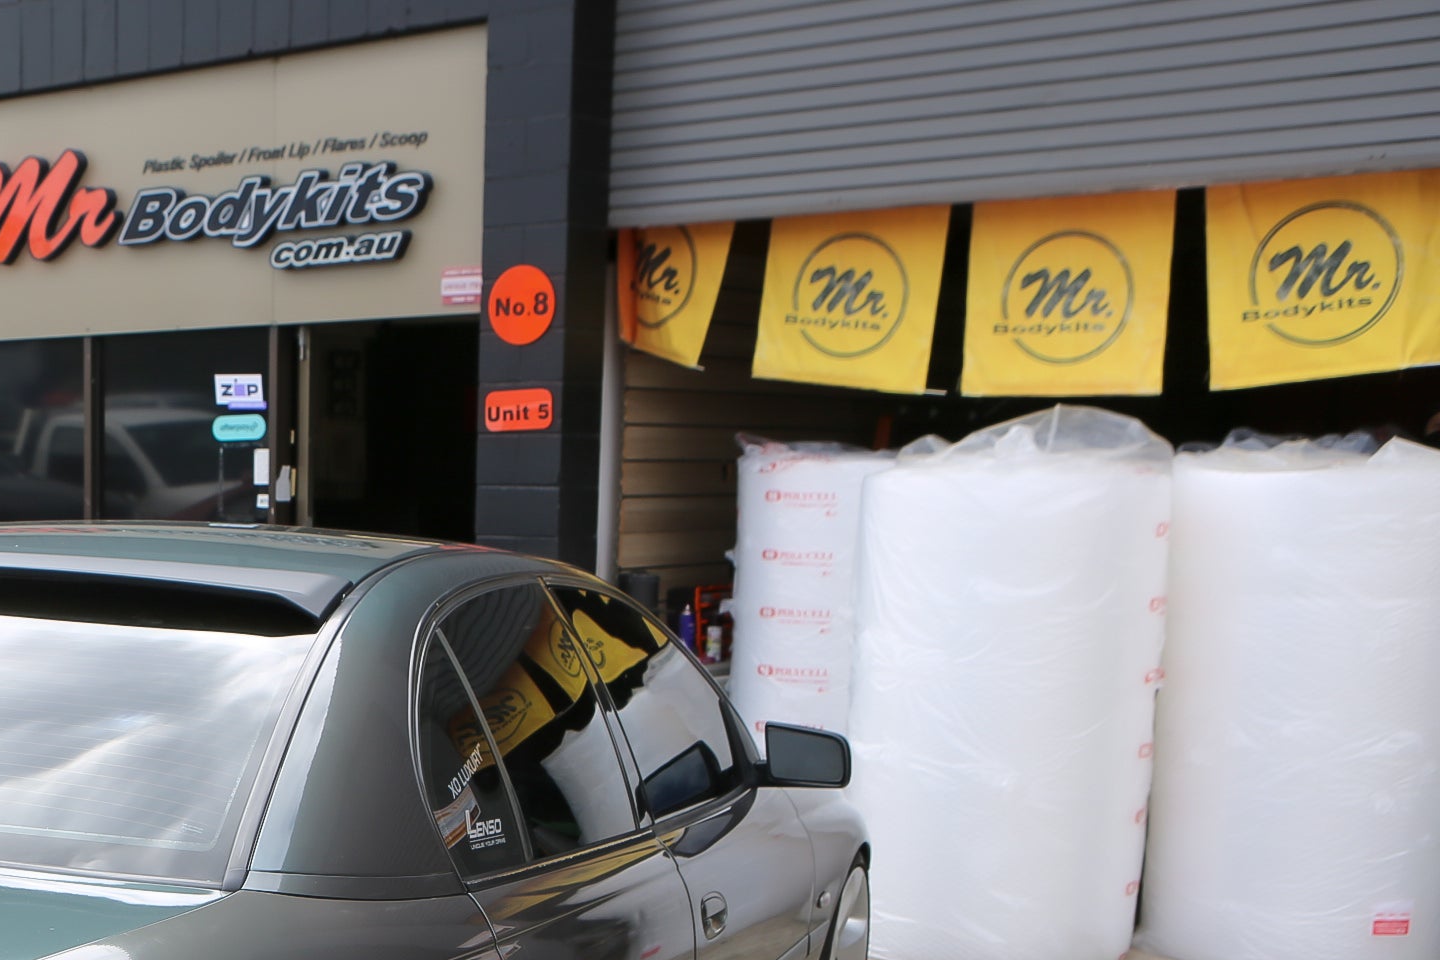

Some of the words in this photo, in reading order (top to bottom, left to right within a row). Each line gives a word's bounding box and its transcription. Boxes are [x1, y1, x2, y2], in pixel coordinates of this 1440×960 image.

[143, 157, 185, 174] Plastic
[189, 153, 238, 171] Spoiler
[247, 142, 285, 162] Front
[288, 142, 311, 160] Lip
[321, 136, 366, 154] Flares
[379, 131, 429, 149] Scoop
[118, 160, 434, 249] Bodykits
[269, 230, 412, 271] com.au
[1268, 239, 1382, 303] Mr.
[810, 264, 890, 319] Mr.
[1020, 267, 1114, 320] Mr.
[1241, 296, 1374, 323] Bodykits
[785, 313, 883, 331] Bodykits
[992, 322, 1107, 335] Bodykits
[487, 405, 531, 422] Unit
[538, 403, 550, 420] 5
[448, 776, 462, 799] XO
[457, 742, 483, 786] LUXURY
